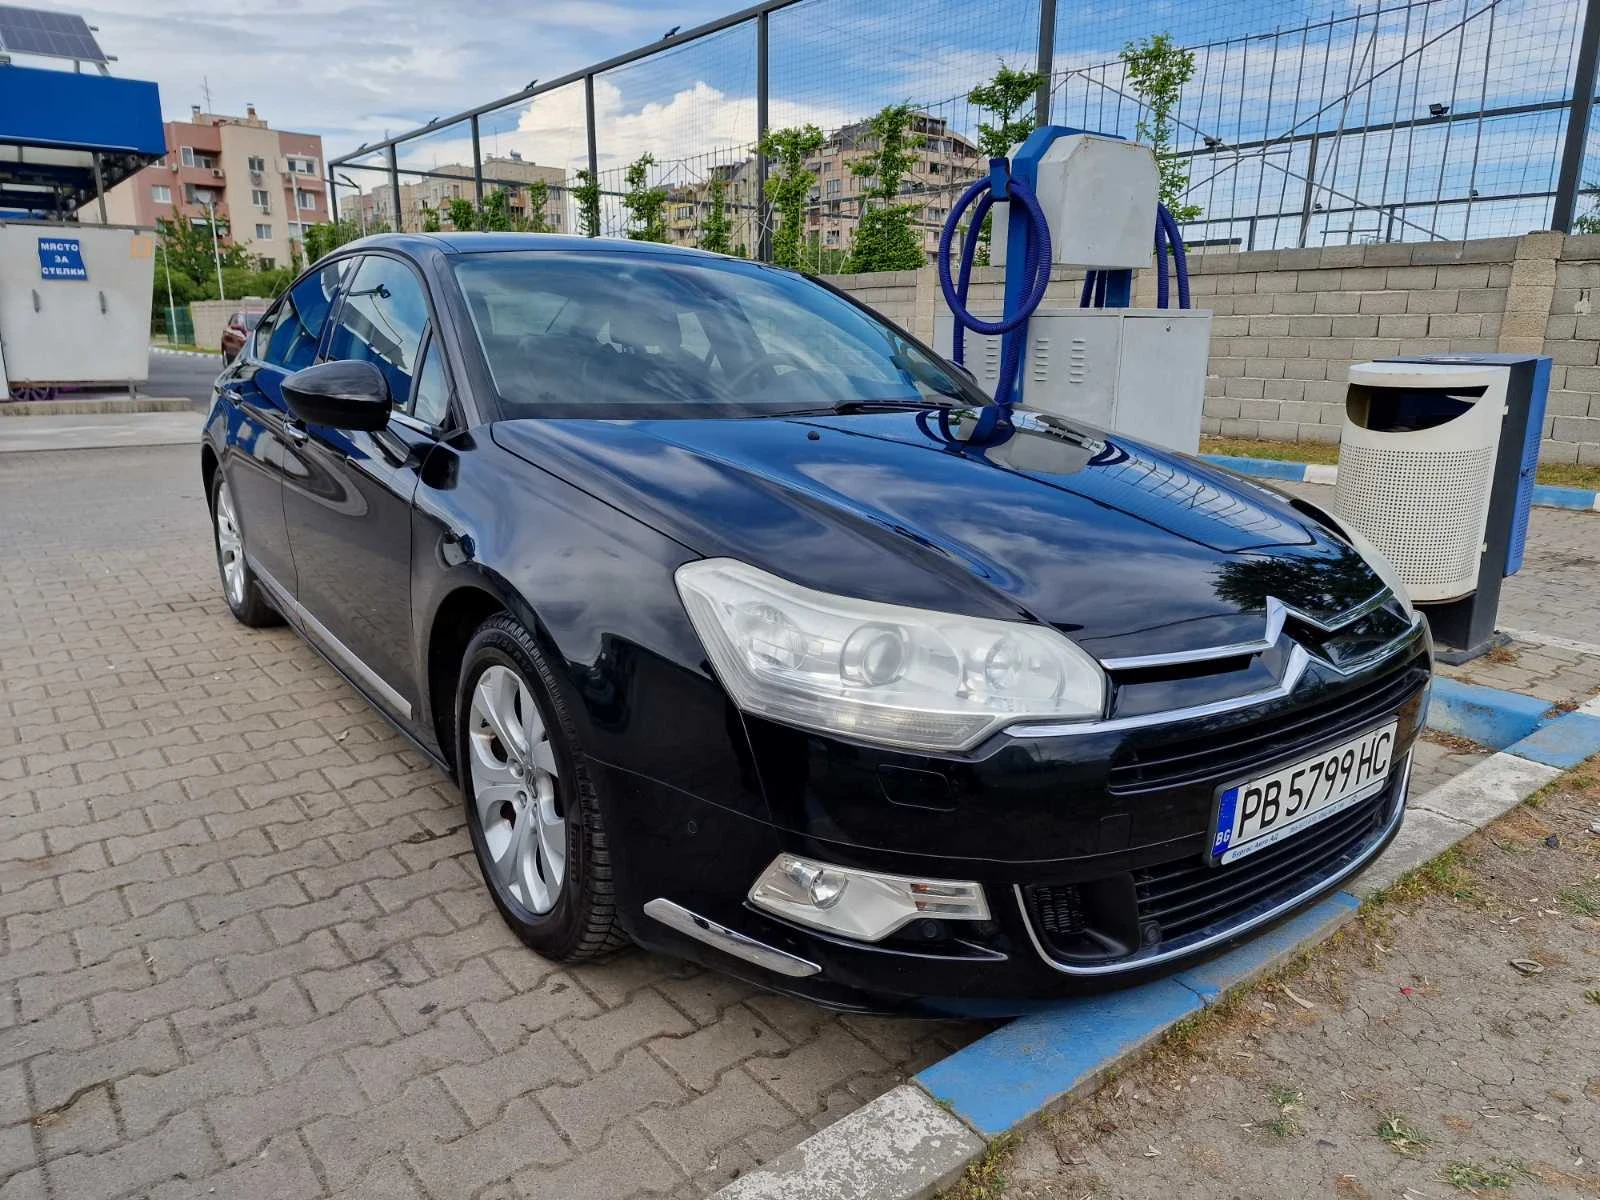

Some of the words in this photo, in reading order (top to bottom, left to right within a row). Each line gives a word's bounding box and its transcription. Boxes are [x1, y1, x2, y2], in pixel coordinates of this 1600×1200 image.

[41, 243, 79, 251] МЯСТО
[54, 255, 69, 263] ЗА
[42, 267, 85, 275] СТЕЛКИ
[1238, 780, 1282, 838] PB
[1285, 749, 1355, 816] 5799
[1215, 829, 1231, 846] BG
